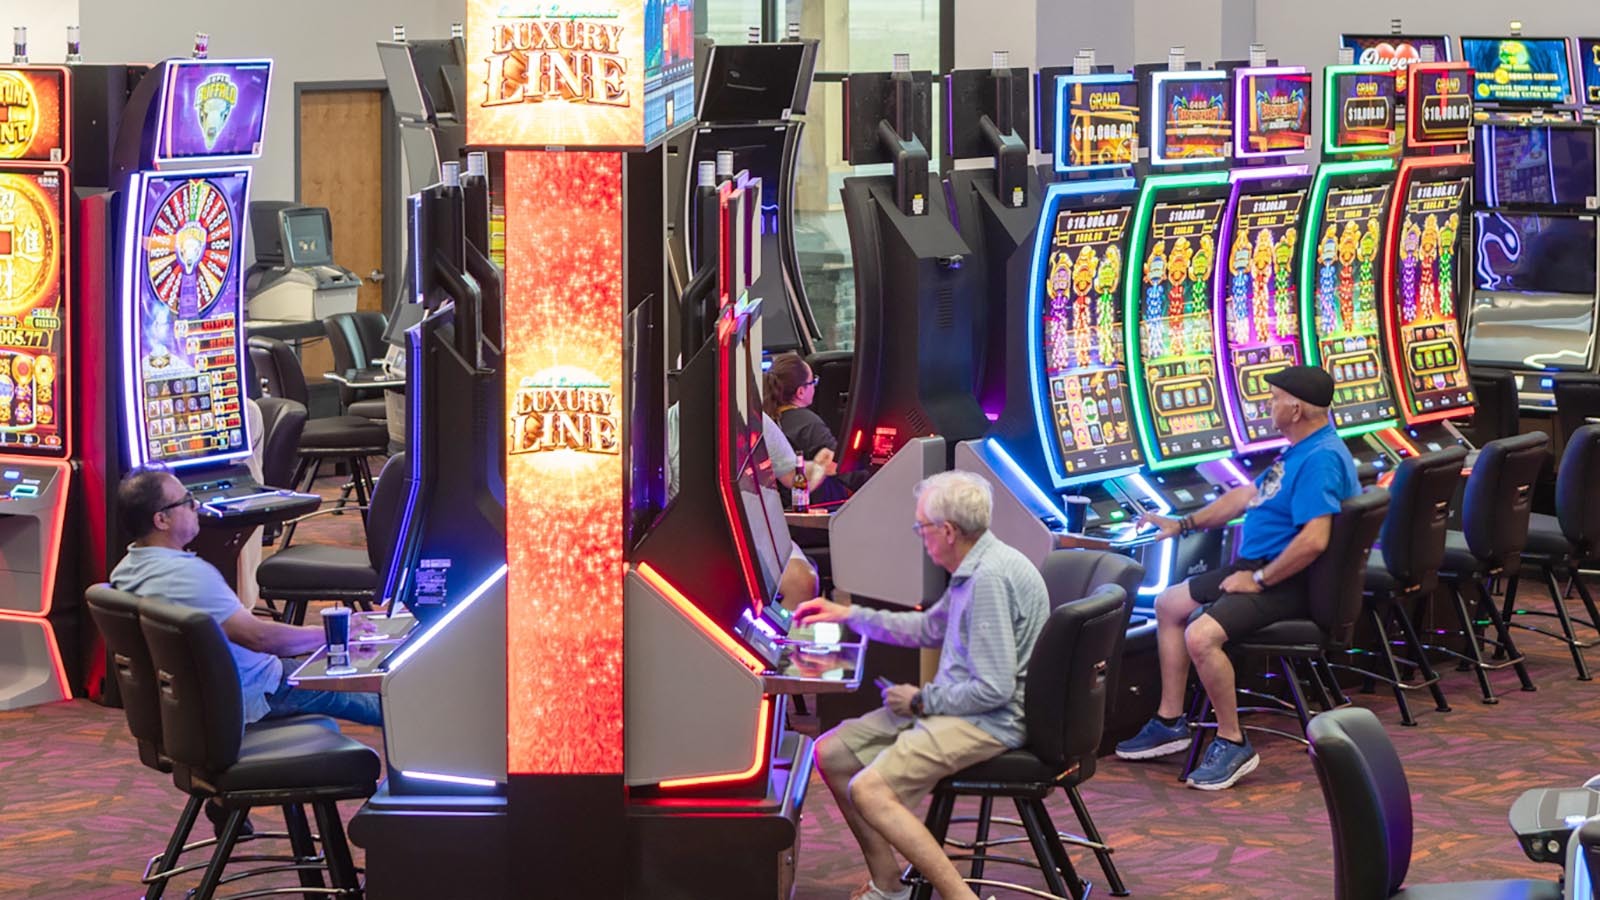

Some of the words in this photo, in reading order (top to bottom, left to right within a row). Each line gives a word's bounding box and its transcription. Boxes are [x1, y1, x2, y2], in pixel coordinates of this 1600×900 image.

[492, 20, 624, 54] LUXURY
[481, 50, 630, 107] LINE
[1435, 78, 1461, 94] GRAND
[1089, 92, 1121, 110] GRAND
[1075, 123, 1133, 142] $10,000.00
[517, 390, 615, 415] LUXURY
[509, 413, 619, 455] LINE
